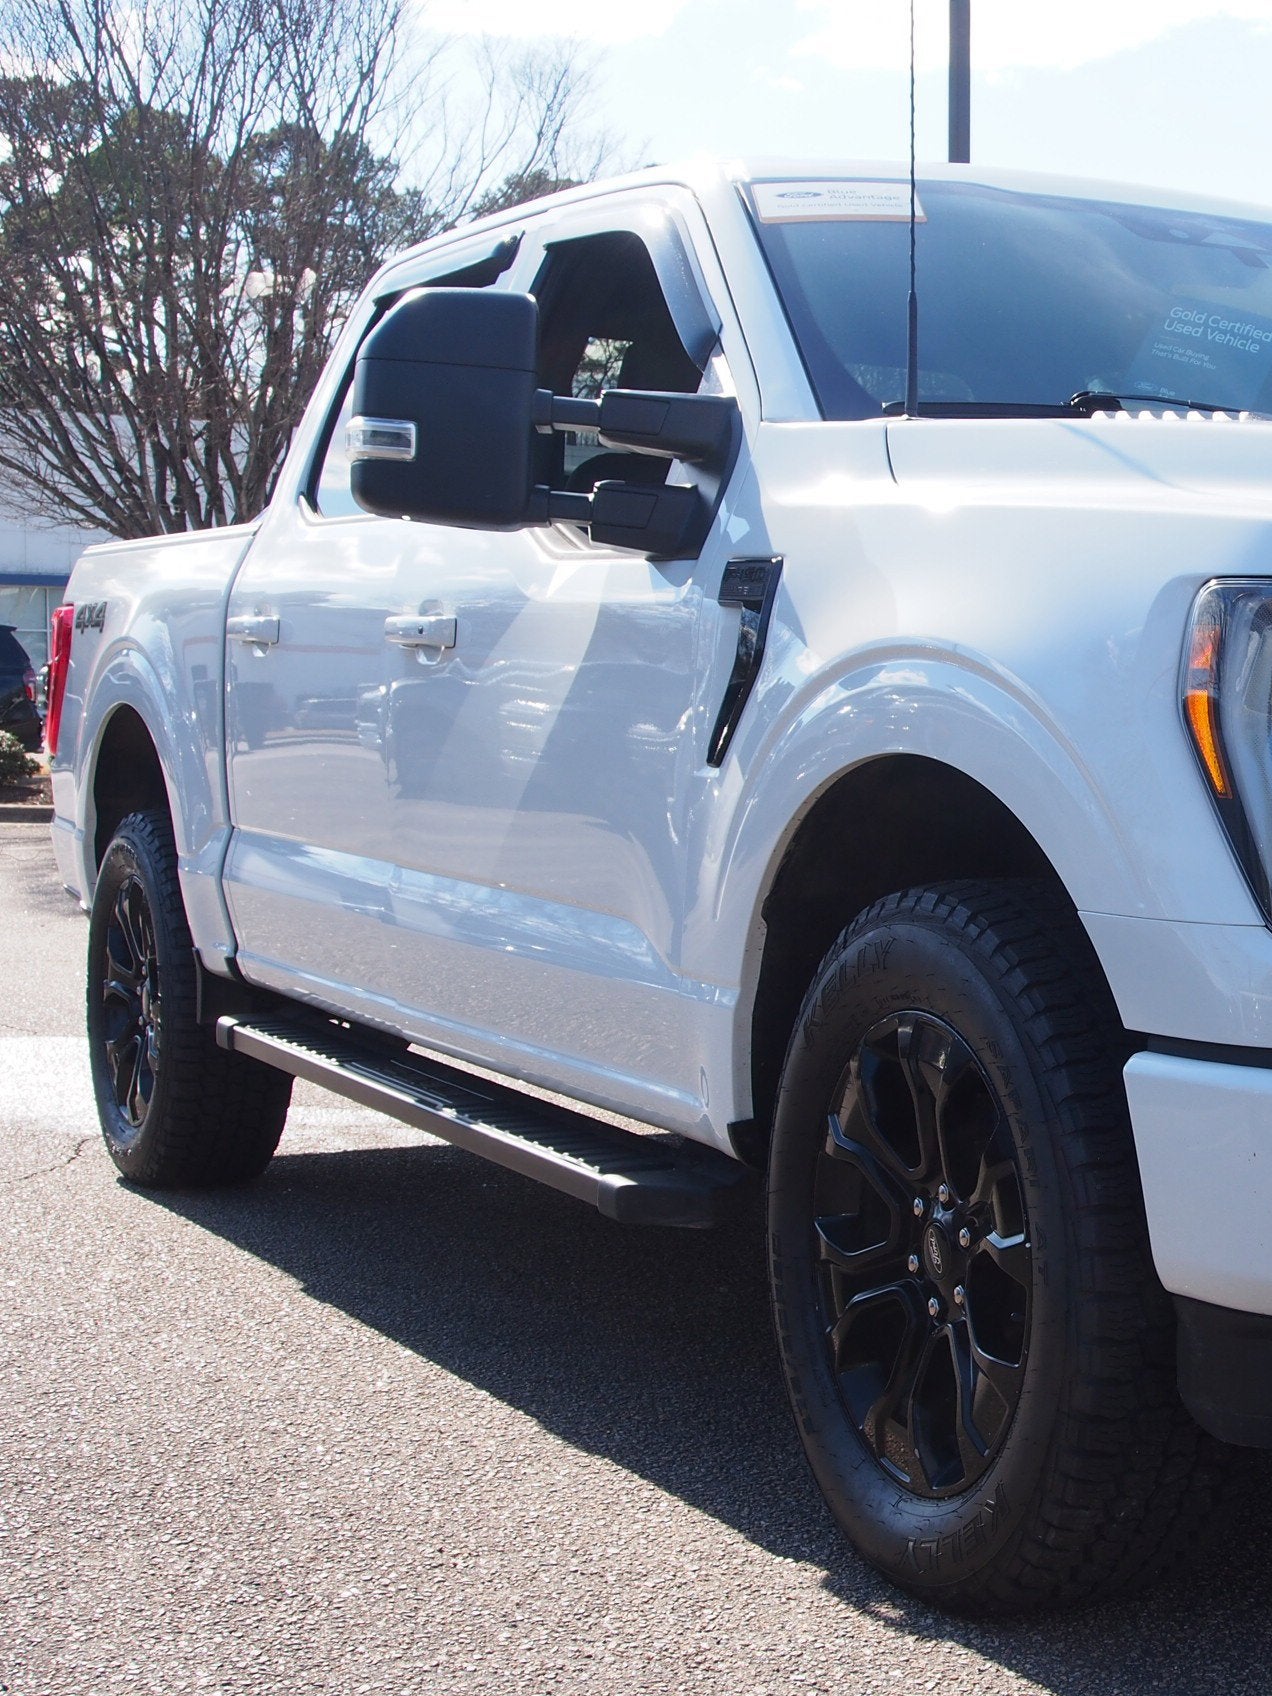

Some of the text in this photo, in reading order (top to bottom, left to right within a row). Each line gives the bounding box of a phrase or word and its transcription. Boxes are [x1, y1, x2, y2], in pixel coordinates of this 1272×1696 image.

[1170, 306, 1207, 324] Gold
[1164, 319, 1260, 353] Used Vehicle
[1152, 349, 1172, 358] That's
[1173, 353, 1189, 362] Built
[1203, 360, 1216, 370] You
[1154, 342, 1173, 351] Used
[1185, 349, 1210, 361] Buying
[801, 935, 897, 1049] KELLY
[899, 1481, 1012, 1575] KELLY
